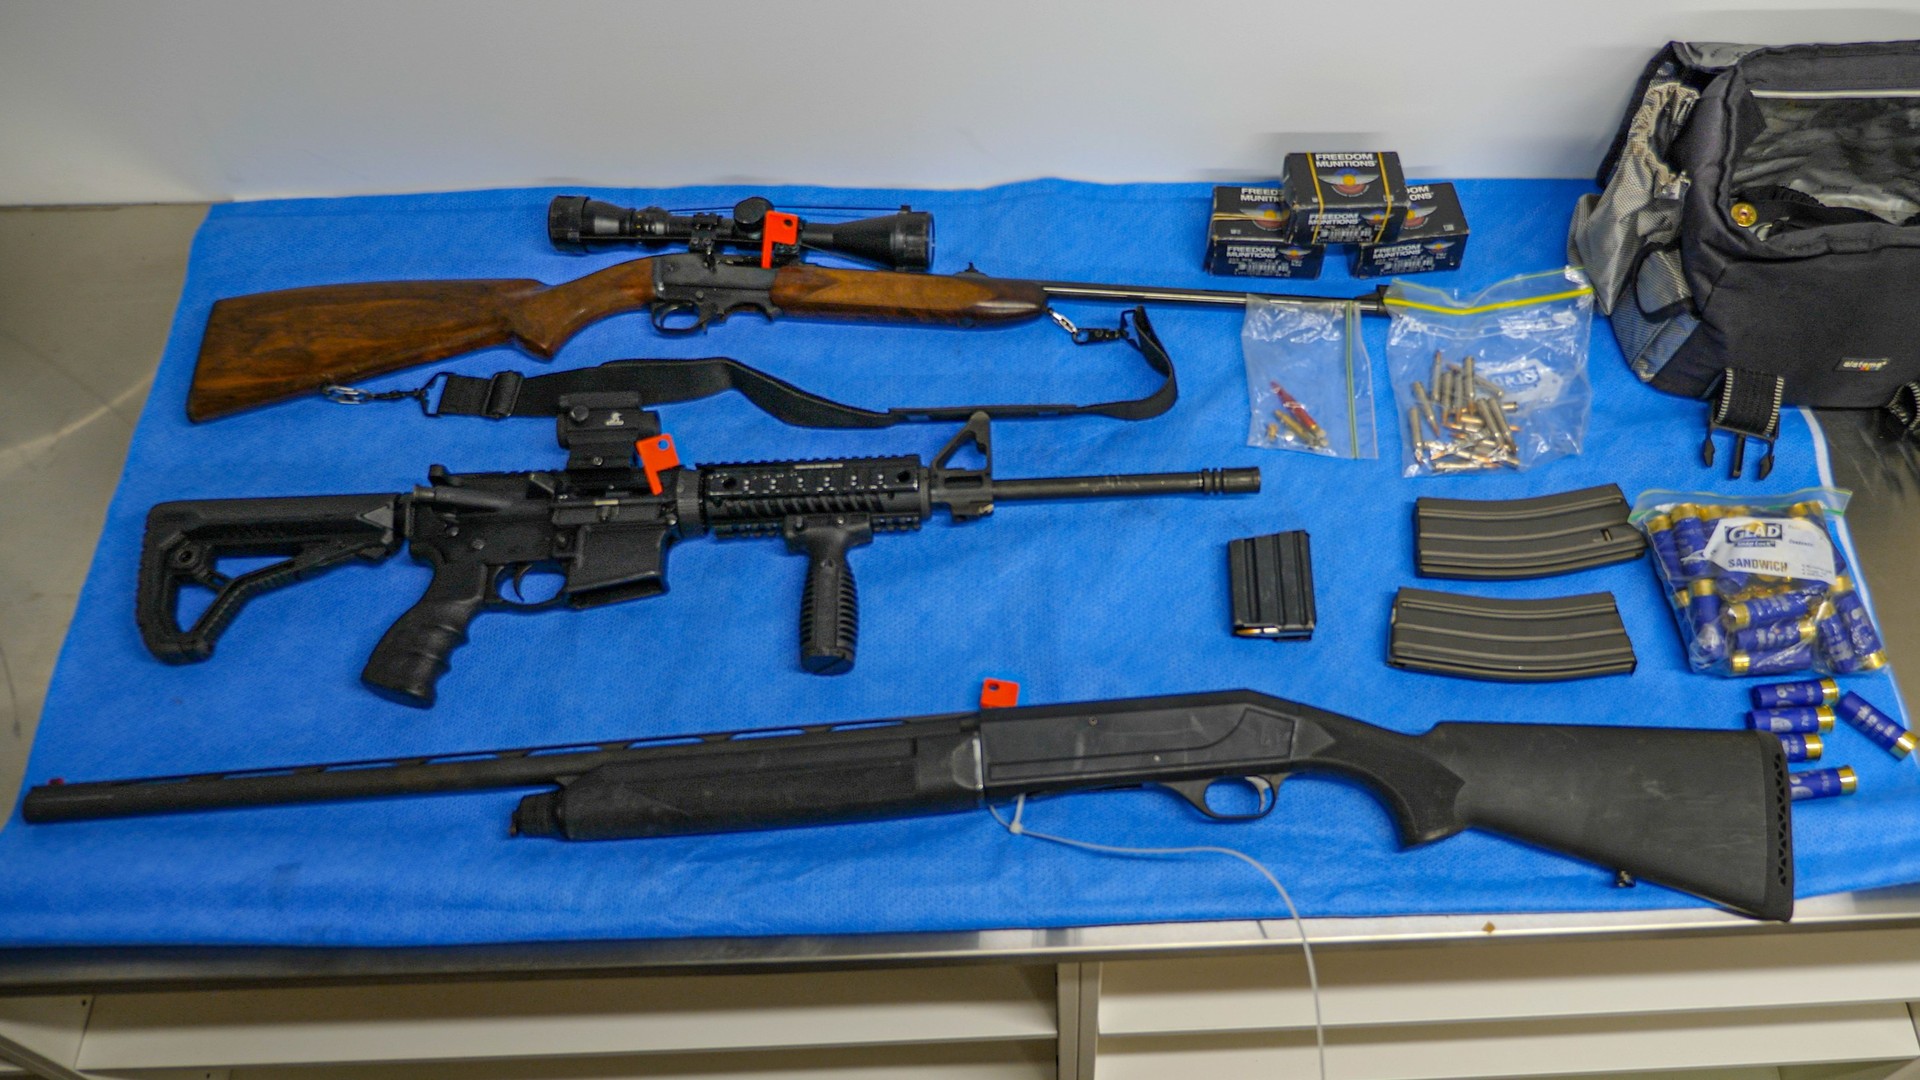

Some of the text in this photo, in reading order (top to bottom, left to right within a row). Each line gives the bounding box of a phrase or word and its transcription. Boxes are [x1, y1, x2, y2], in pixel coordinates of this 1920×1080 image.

[1315, 153, 1374, 161] FREEDOM
[1315, 160, 1377, 168] MUNITIONS
[1409, 192, 1433, 201] ONS
[1373, 244, 1422, 253] FREEDOM
[1372, 249, 1423, 259] MUNITIONS
[1728, 524, 1782, 542] GLAD
[1728, 558, 1788, 572] SANDWICH
